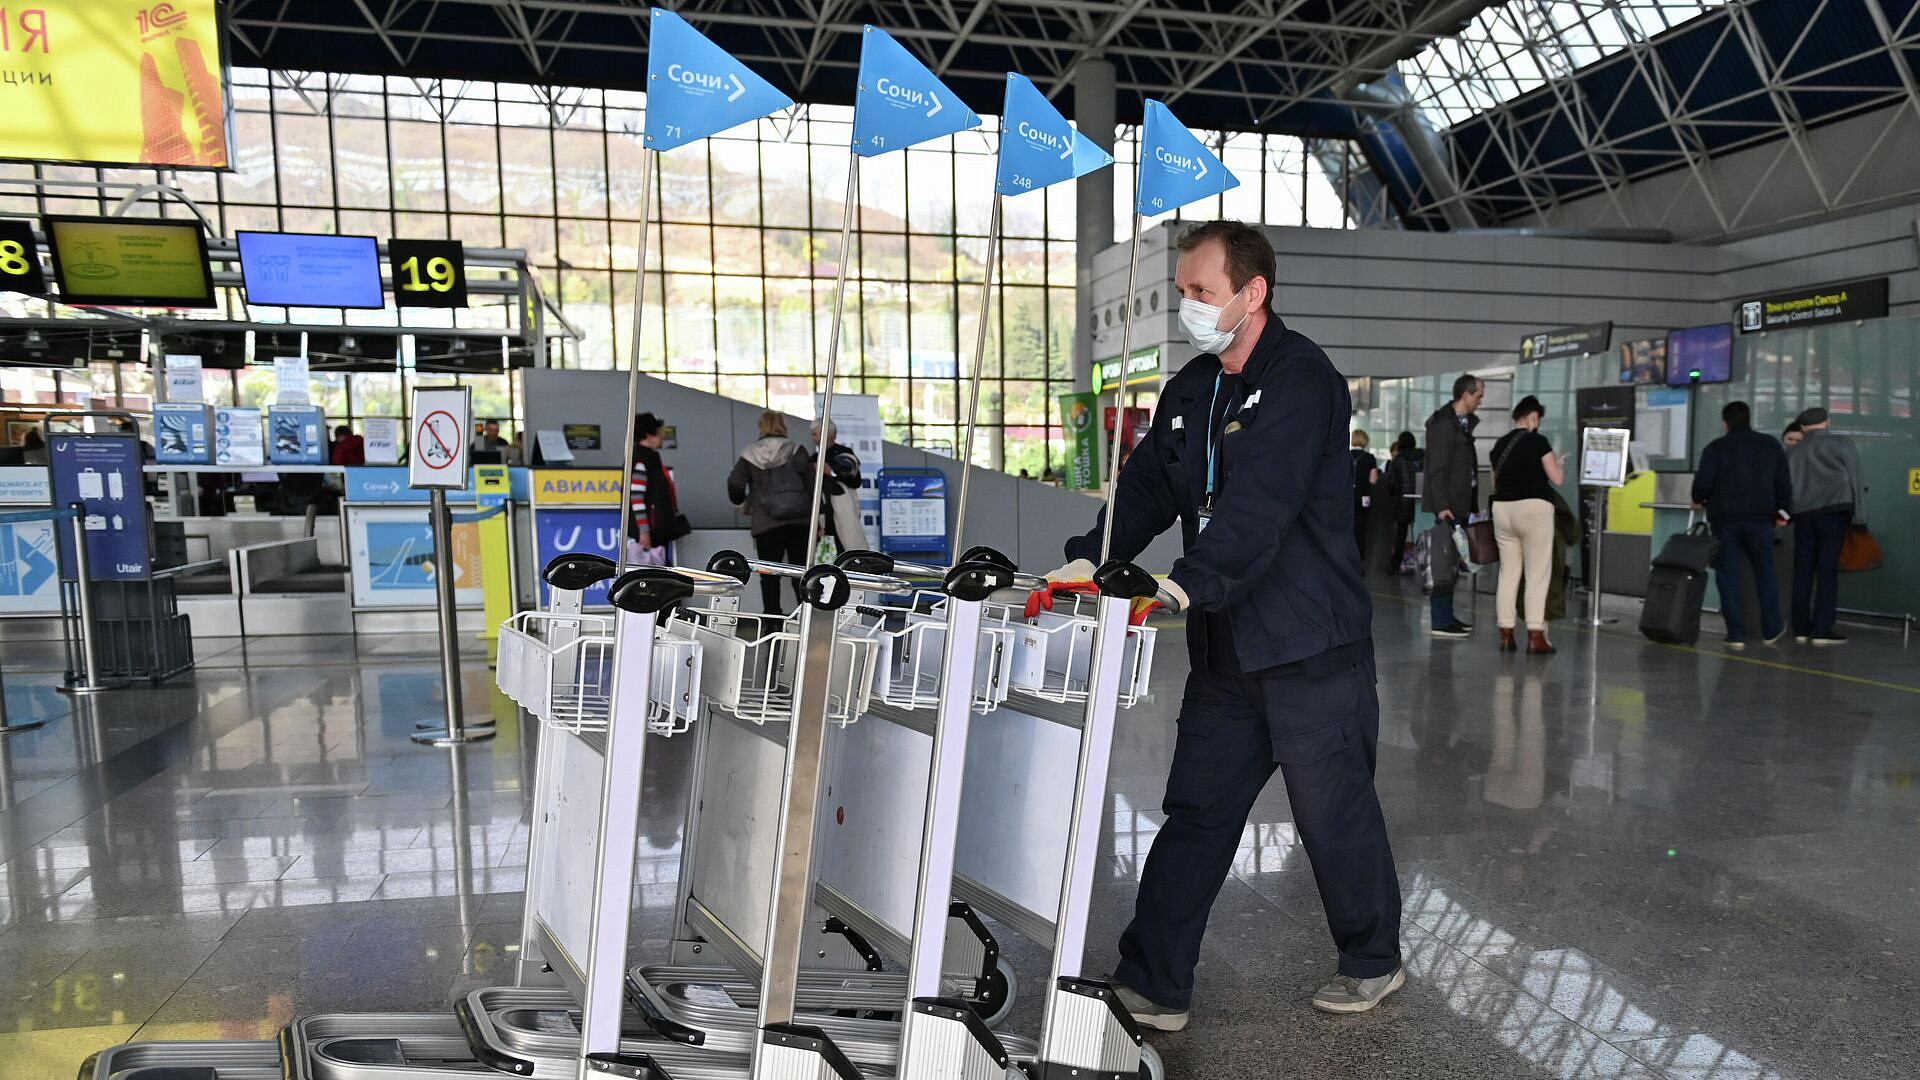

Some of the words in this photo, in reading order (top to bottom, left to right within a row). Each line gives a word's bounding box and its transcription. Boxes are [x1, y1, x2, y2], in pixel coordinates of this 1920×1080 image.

[667, 63, 722, 90] Сочи
[877, 78, 923, 105] Сочи
[665, 124, 681, 139] 71
[1018, 121, 1057, 148] Сочи
[871, 135, 885, 148] 41
[1155, 146, 1192, 169] Сочи
[1012, 174, 1032, 189] 248
[1151, 197, 1163, 208] 40
[400, 256, 456, 293] 19
[1791, 310, 1814, 321] Control
[1814, 306, 1836, 317] Sector
[116, 563, 142, 574] Utair
